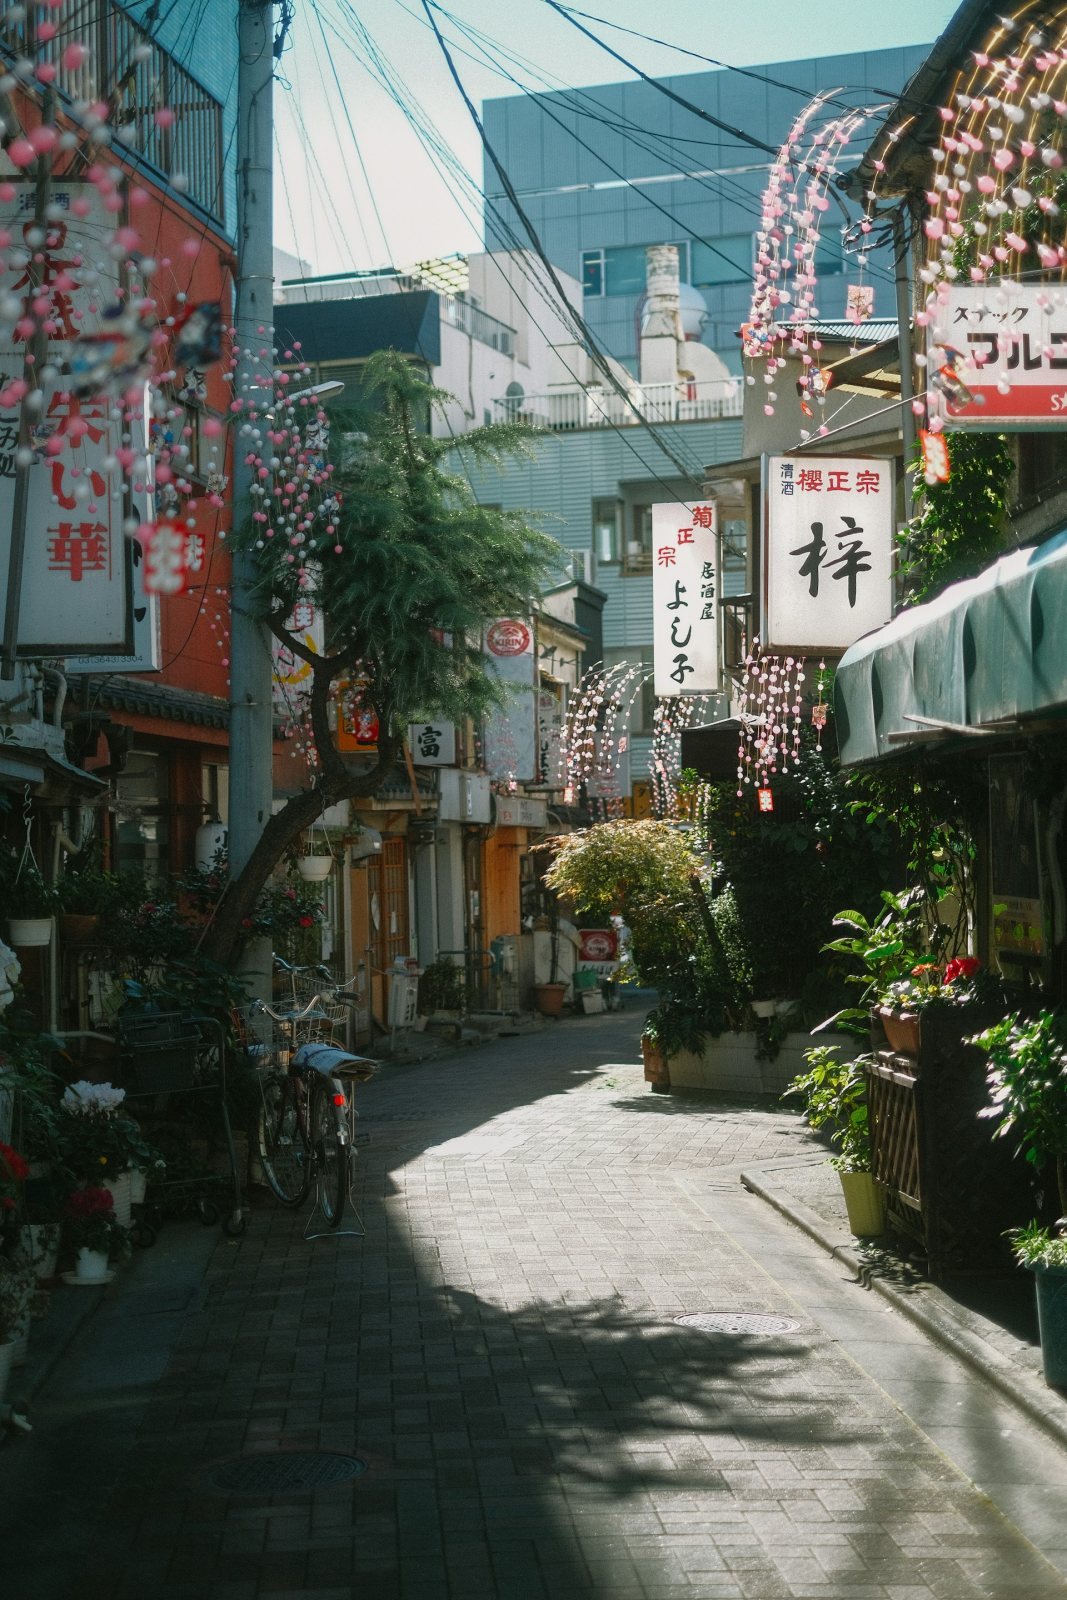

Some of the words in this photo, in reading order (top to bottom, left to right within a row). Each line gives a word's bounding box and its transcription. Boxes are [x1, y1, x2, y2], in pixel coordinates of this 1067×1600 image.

[20, 193, 70, 211] 清酒
[953, 307, 1029, 324] スナック
[46, 391, 108, 582] 朱い華
[780, 463, 794, 495] 清酒
[796, 470, 880, 494] 櫻正宗
[657, 506, 713, 568] 菊正宗
[789, 516, 872, 608] 梓
[700, 562, 715, 620] 居酒屋
[495, 638, 521, 648] KIRIN
[666, 580, 695, 684] よし子
[418, 726, 442, 758] 富
